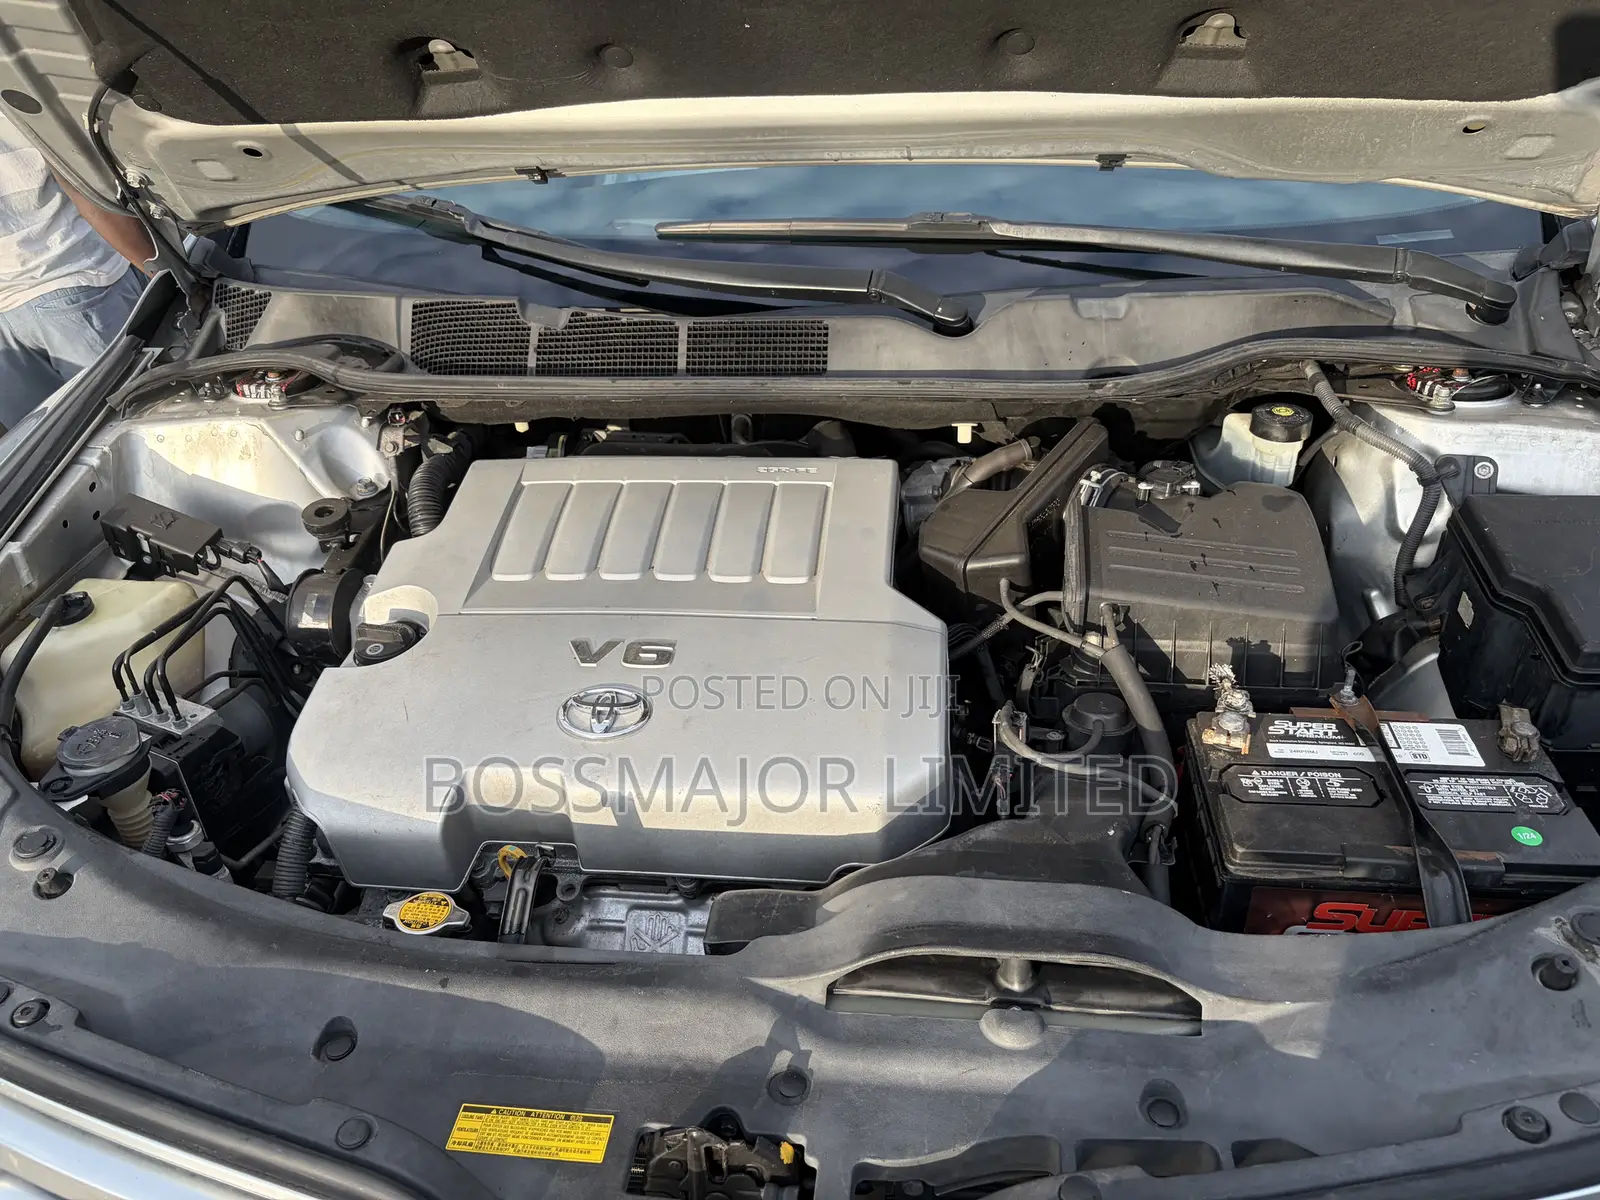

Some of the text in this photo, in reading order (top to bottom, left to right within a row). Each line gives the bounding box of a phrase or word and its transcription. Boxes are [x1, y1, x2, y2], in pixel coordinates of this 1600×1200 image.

[568, 638, 678, 669] V6
[1274, 720, 1337, 730] SUPER
[1268, 726, 1339, 736] START
[1516, 831, 1537, 840] 1/24
[498, 1109, 566, 1120] CAUTION ATTENTION
